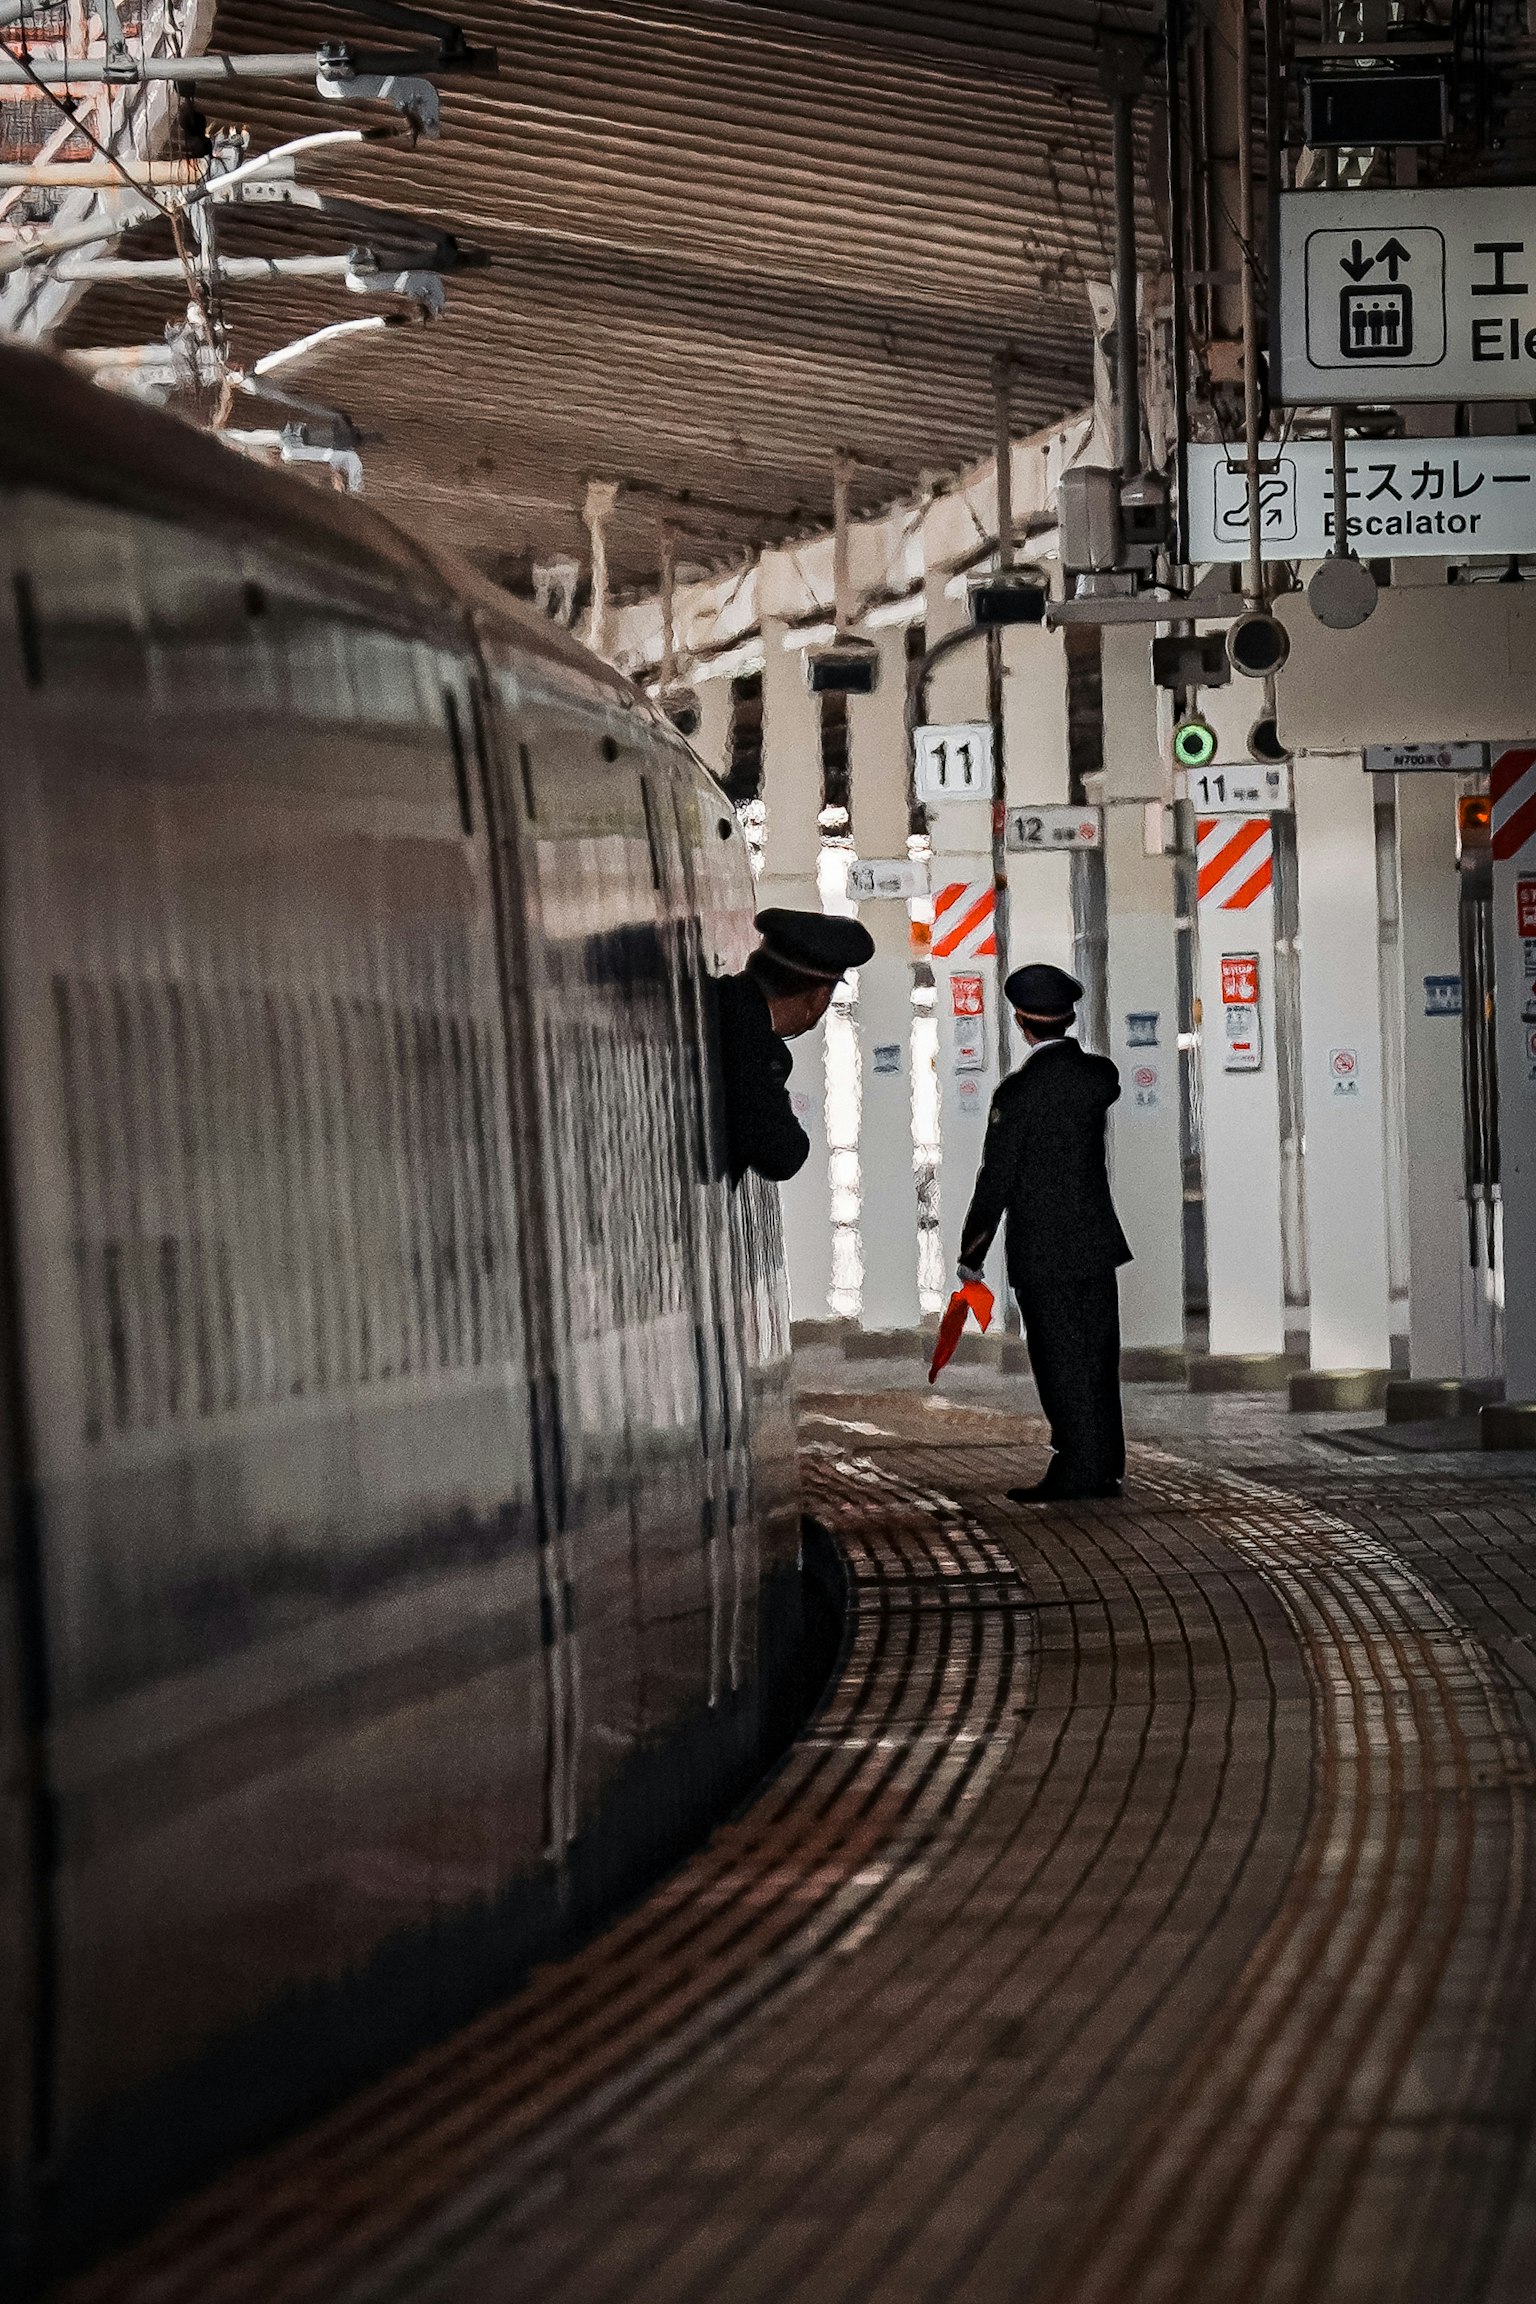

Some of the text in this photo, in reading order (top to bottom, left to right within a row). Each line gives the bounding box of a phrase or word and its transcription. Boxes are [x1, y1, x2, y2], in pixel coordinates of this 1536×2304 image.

[1471, 242, 1528, 295] エ
[930, 740, 973, 785] 11
[1197, 774, 1225, 804] 11
[1015, 817, 1043, 842] 12
